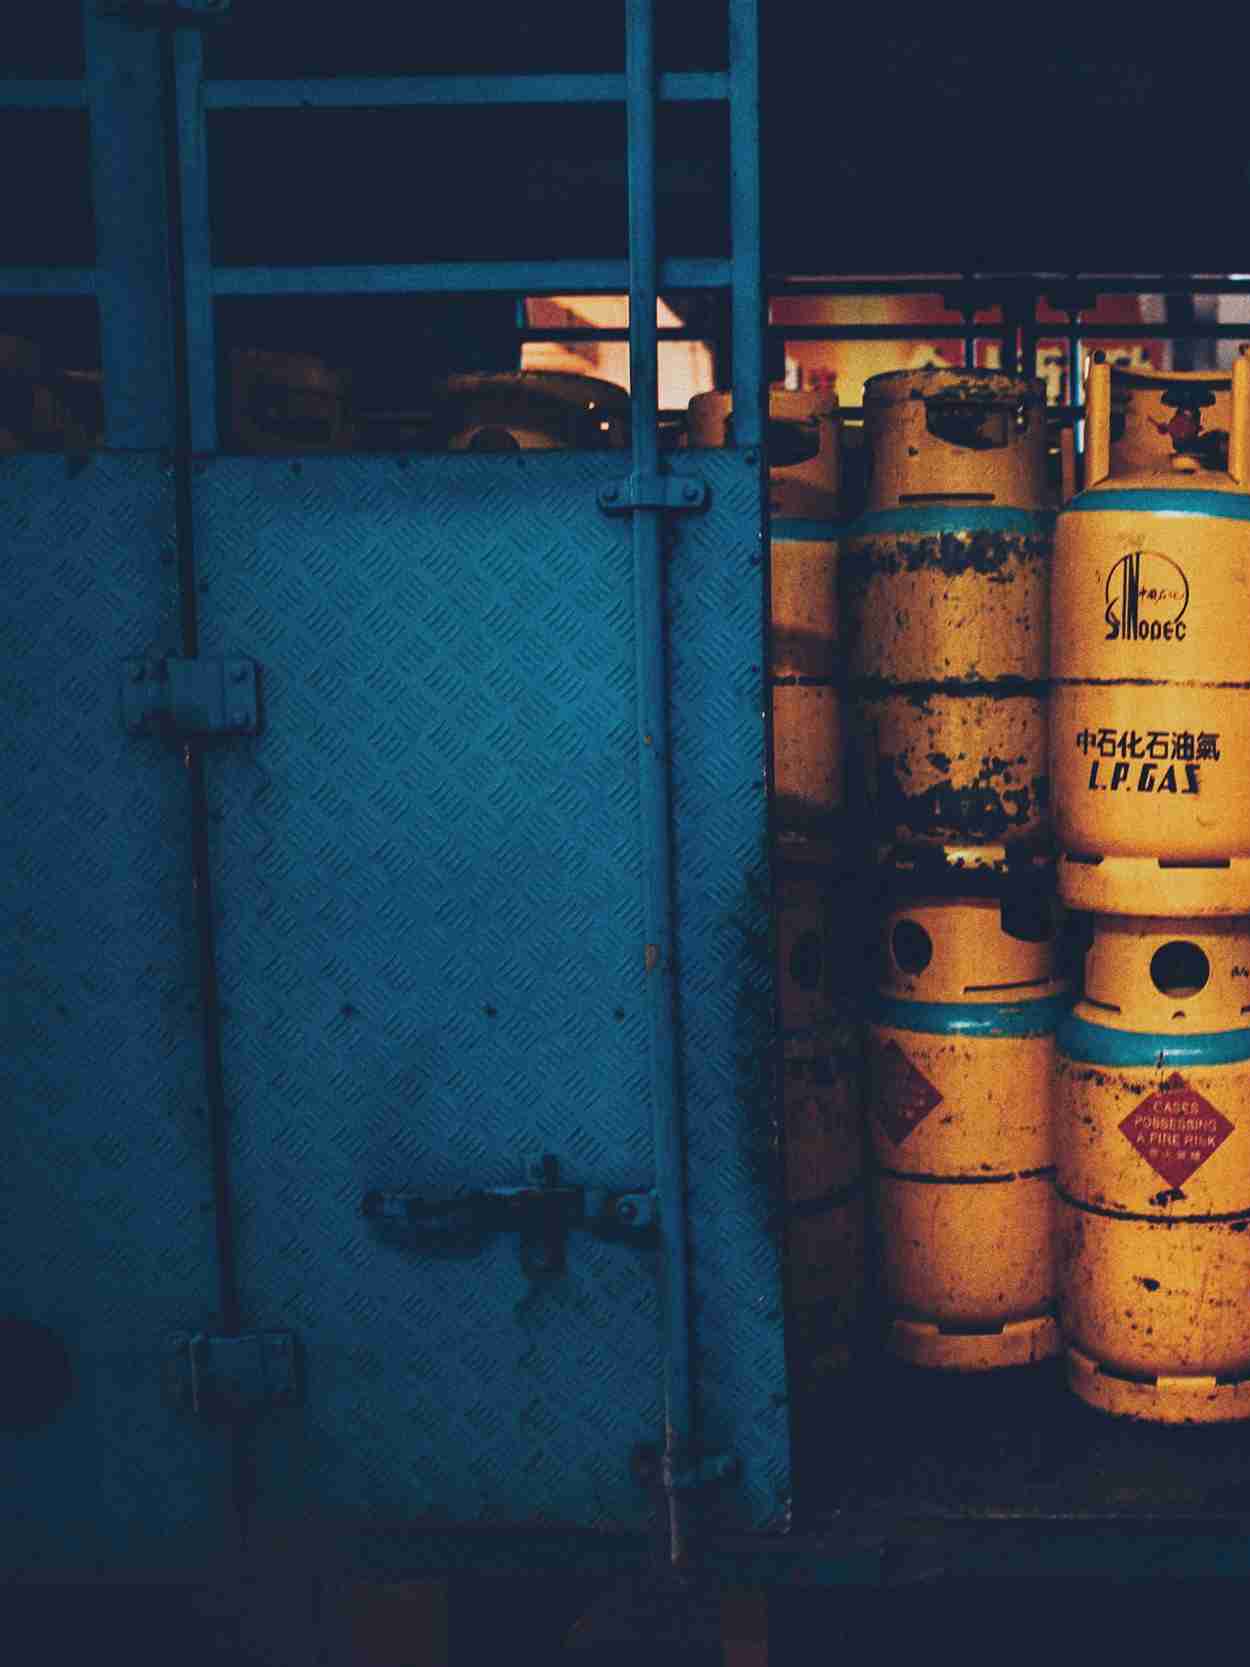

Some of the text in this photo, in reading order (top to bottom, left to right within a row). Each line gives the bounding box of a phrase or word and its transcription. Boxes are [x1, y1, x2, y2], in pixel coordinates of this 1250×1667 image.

[1076, 728, 1220, 761] 中石化石油氣
